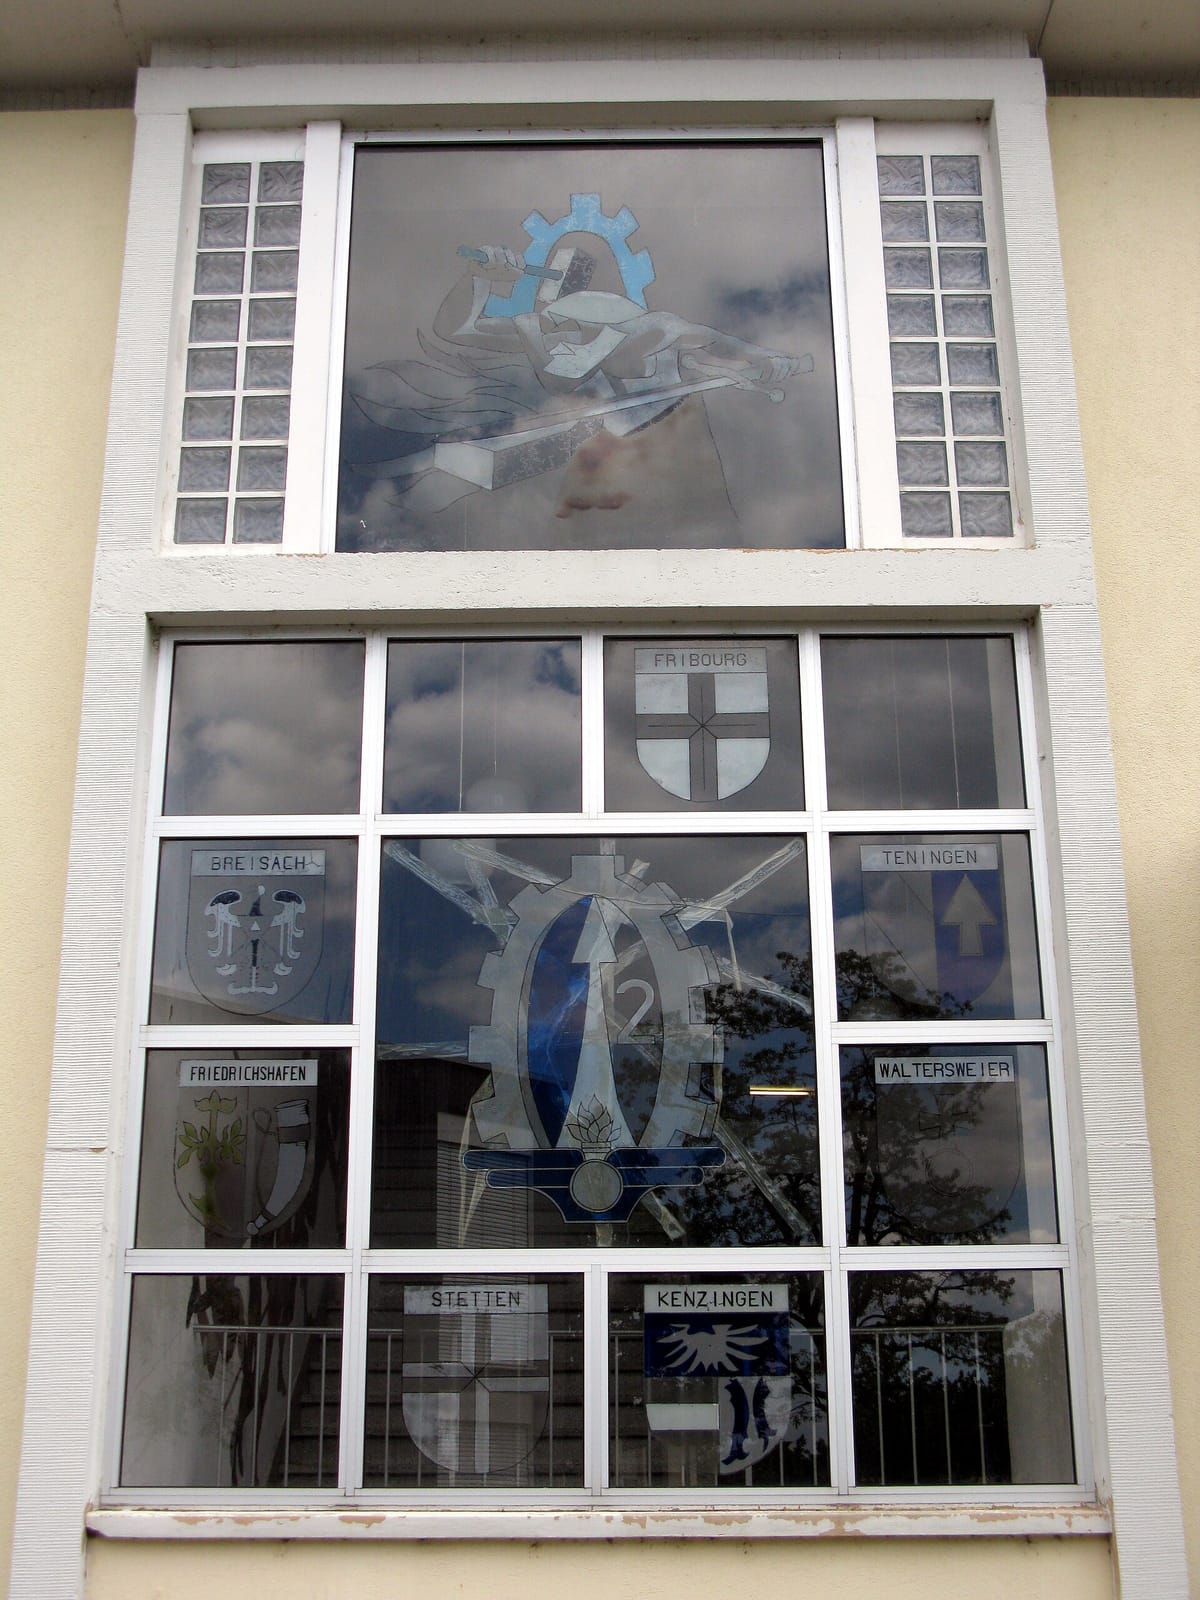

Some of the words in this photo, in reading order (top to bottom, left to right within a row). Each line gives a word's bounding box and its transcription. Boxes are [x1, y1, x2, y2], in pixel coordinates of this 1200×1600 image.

[654, 652, 748, 667] FRIBOURG
[210, 856, 306, 871] BREISACH
[882, 850, 977, 865] TENINGEN
[616, 978, 656, 1045] 2
[190, 1066, 307, 1081] FRIEDRICHSHAFEN
[879, 1062, 1011, 1078] WALTERSWEIER
[431, 1291, 521, 1307] STETTEN
[657, 1291, 774, 1307] KENZINGEN
